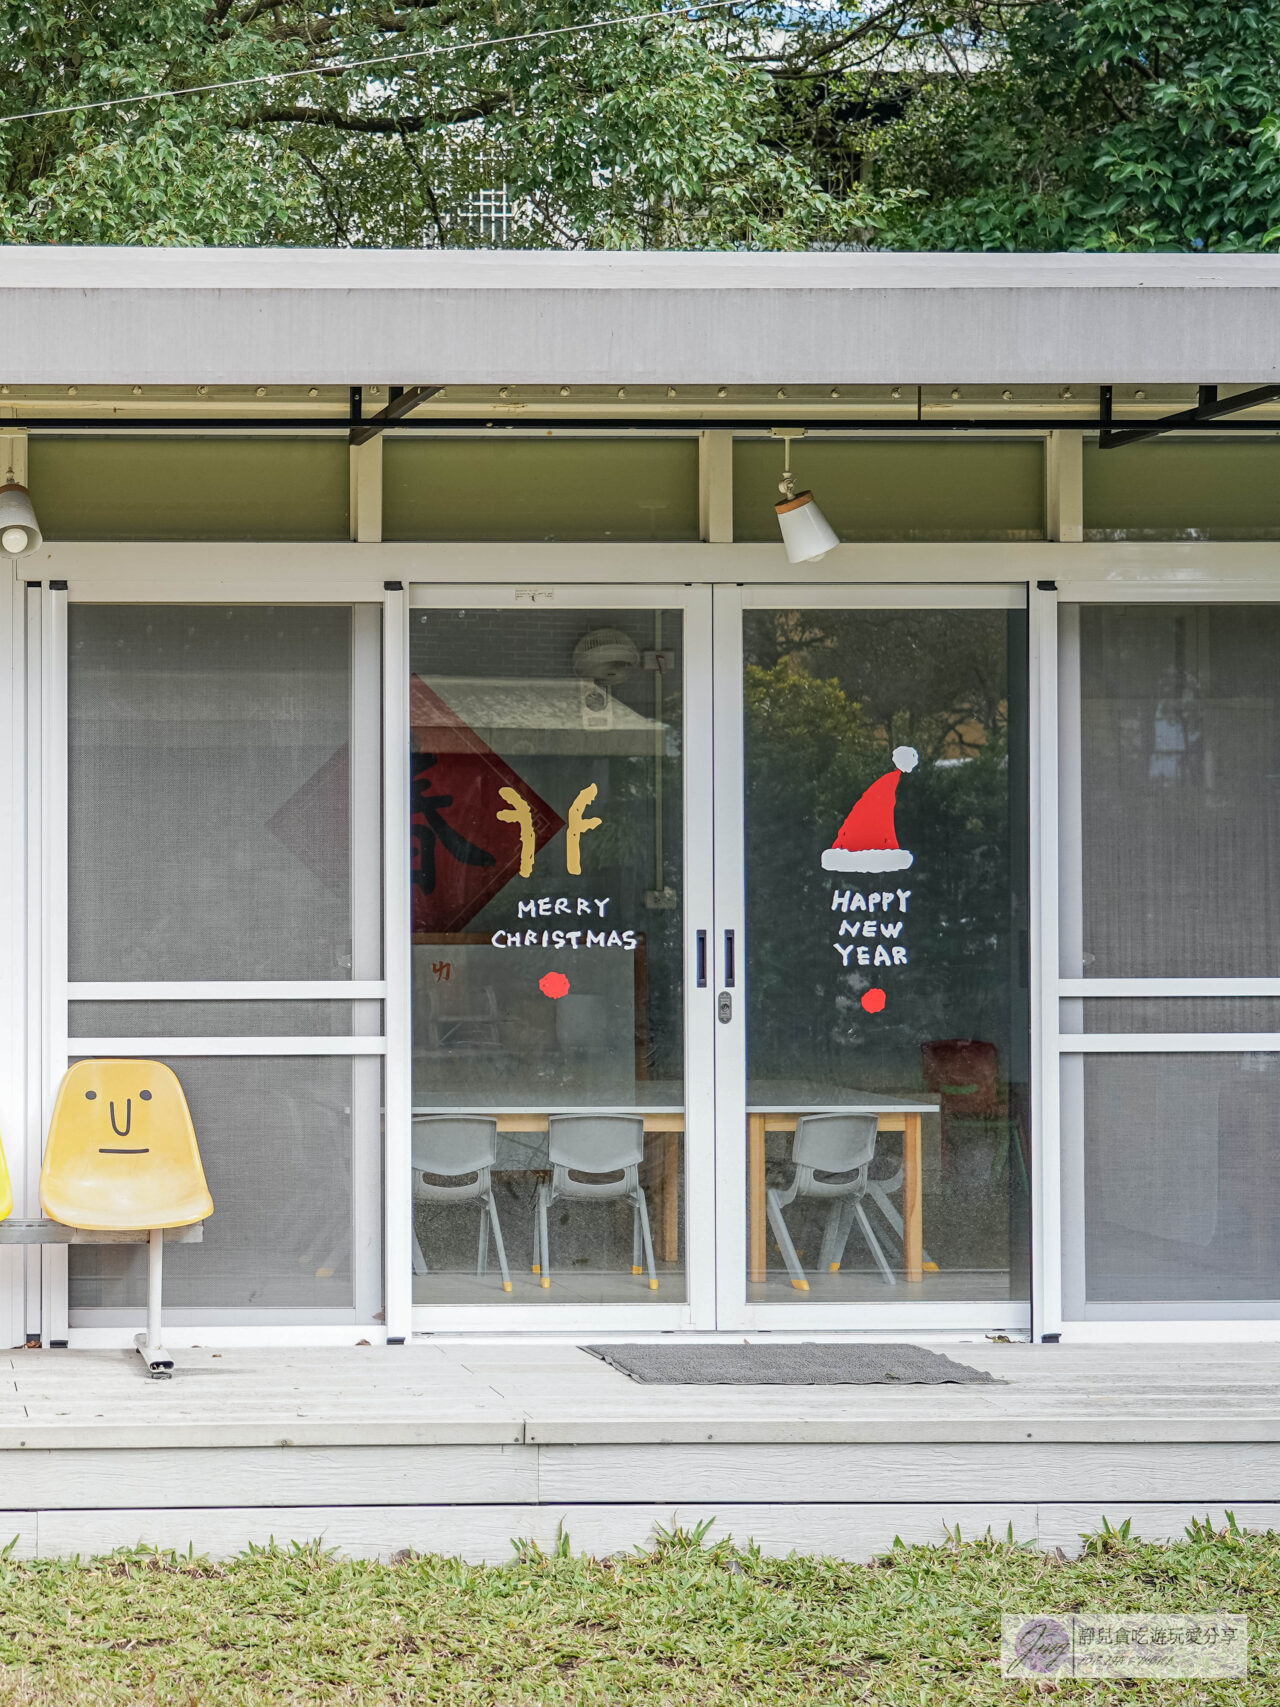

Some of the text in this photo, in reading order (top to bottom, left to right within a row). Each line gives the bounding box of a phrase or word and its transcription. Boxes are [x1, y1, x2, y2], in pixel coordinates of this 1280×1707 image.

[517, 897, 610, 919] MERRY
[831, 889, 912, 913] HAPPY
[491, 929, 638, 951] CHRISTMAS
[838, 919, 904, 939] NEW
[832, 943, 908, 967] YEAR
